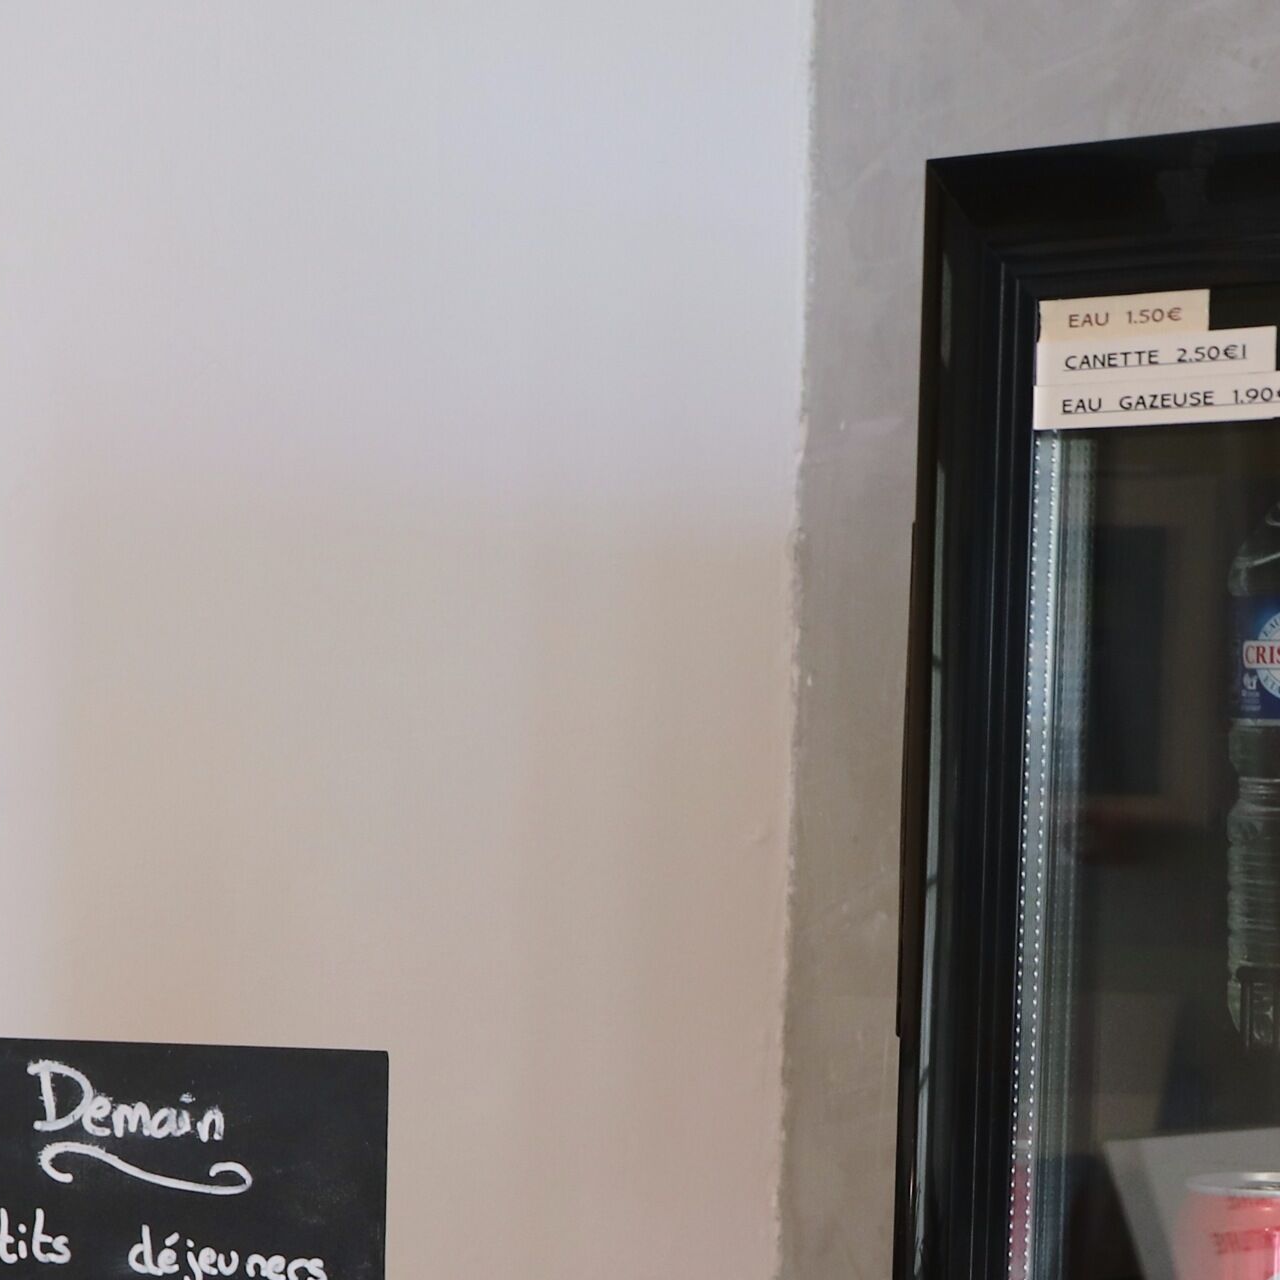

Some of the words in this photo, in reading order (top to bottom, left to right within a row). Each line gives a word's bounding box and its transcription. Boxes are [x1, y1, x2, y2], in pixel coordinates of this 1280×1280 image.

[1069, 312, 1109, 328] EAU
[1126, 307, 1182, 325] 1.50€
[1064, 350, 1159, 370] CANETTE
[1062, 398, 1102, 414] EAU
[1119, 390, 1215, 410] GAZEUSE
[27, 1059, 225, 1141] Demain
